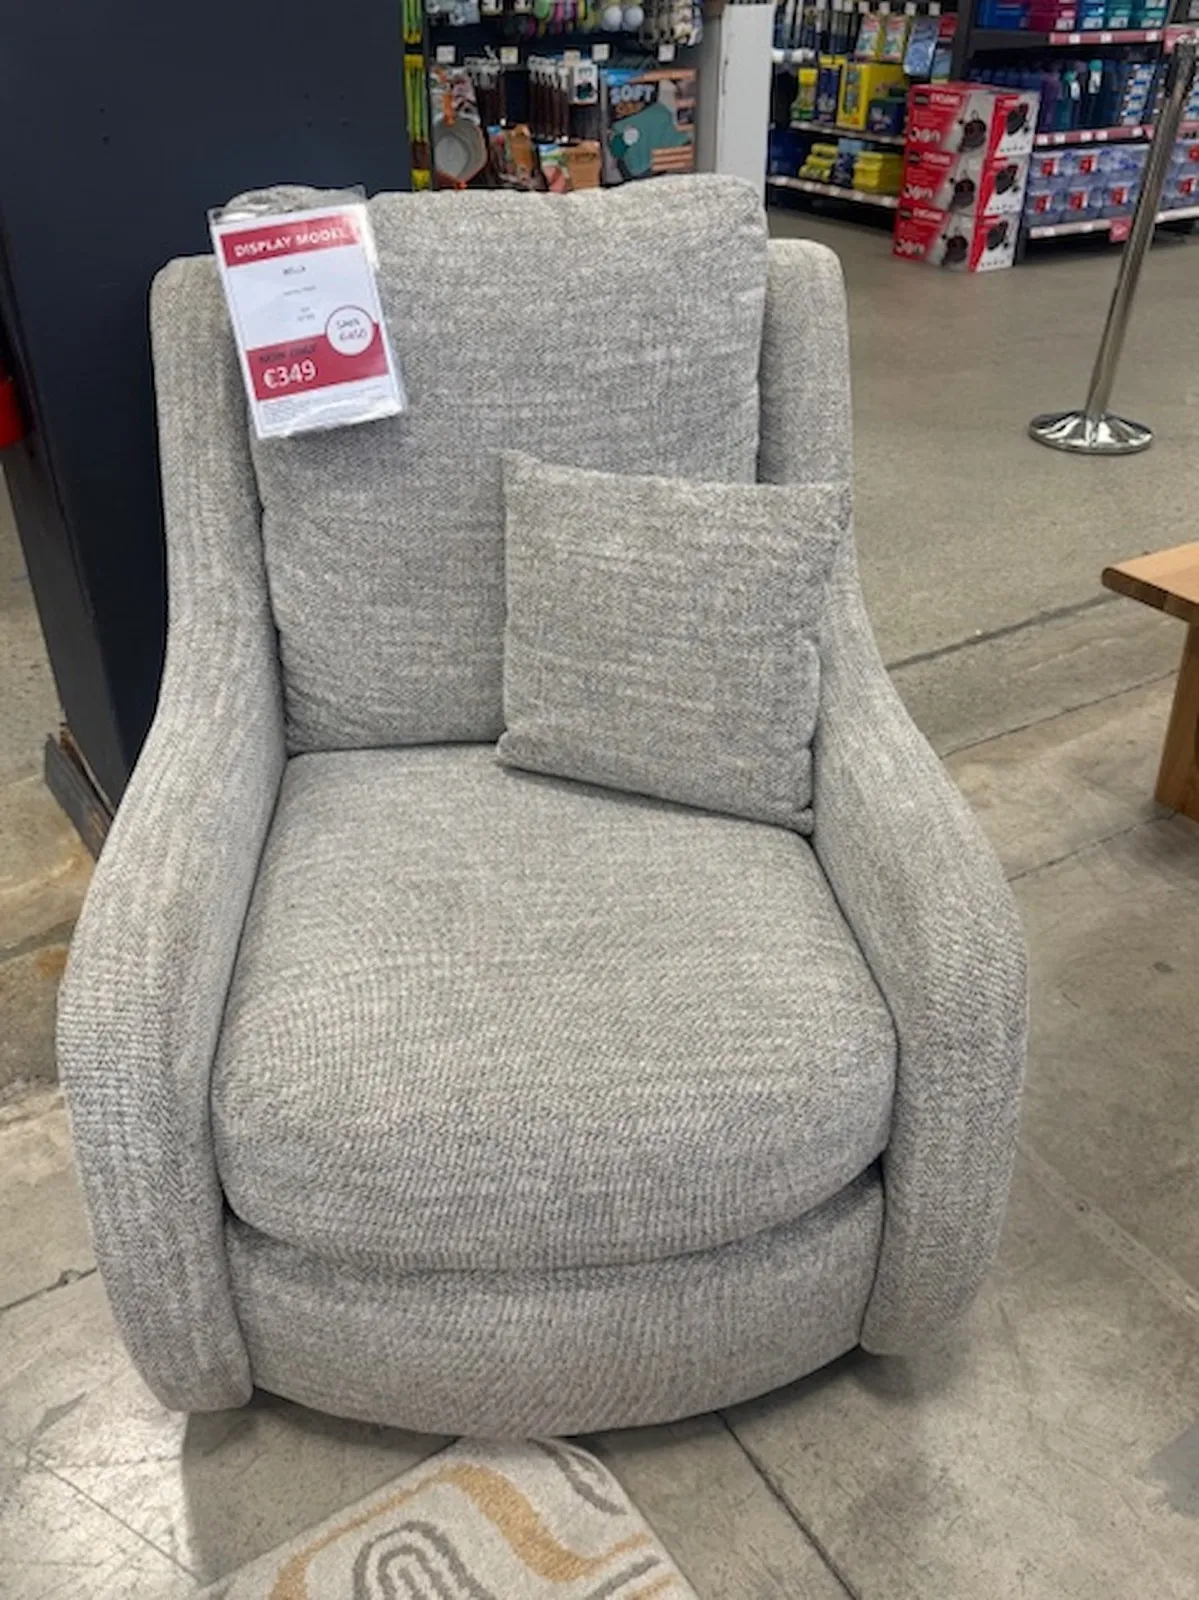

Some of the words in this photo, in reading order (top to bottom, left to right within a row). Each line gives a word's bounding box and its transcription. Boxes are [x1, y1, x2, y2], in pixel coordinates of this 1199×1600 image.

[610, 84, 655, 105] SOFT
[234, 237, 293, 257] DISPLAY
[295, 229, 347, 244] MODEL
[264, 359, 316, 388] €349
